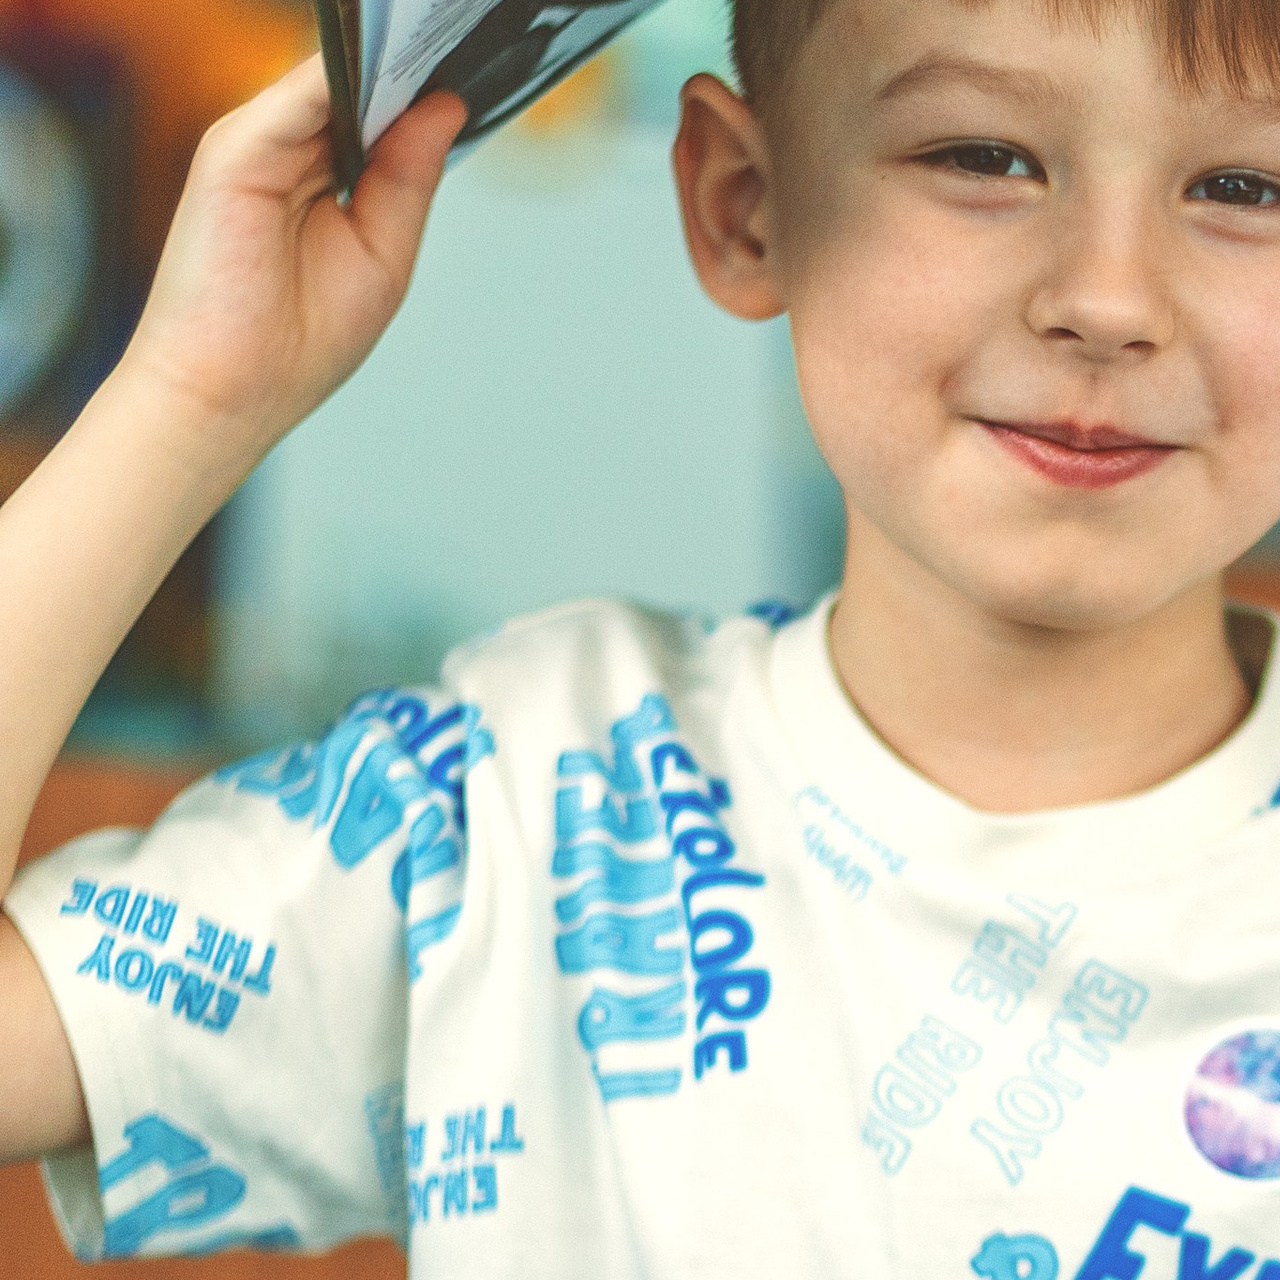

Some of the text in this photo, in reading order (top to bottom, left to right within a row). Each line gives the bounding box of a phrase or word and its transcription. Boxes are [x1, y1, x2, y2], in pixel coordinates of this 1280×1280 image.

[59, 875, 281, 998] THE RIDE
[77, 933, 242, 1038] ENJOY
[862, 891, 1079, 1177] THE RIDE
[971, 956, 1150, 1187] ENJOY
[438, 1100, 525, 1164] THE
[409, 1161, 499, 1224] ENJ
